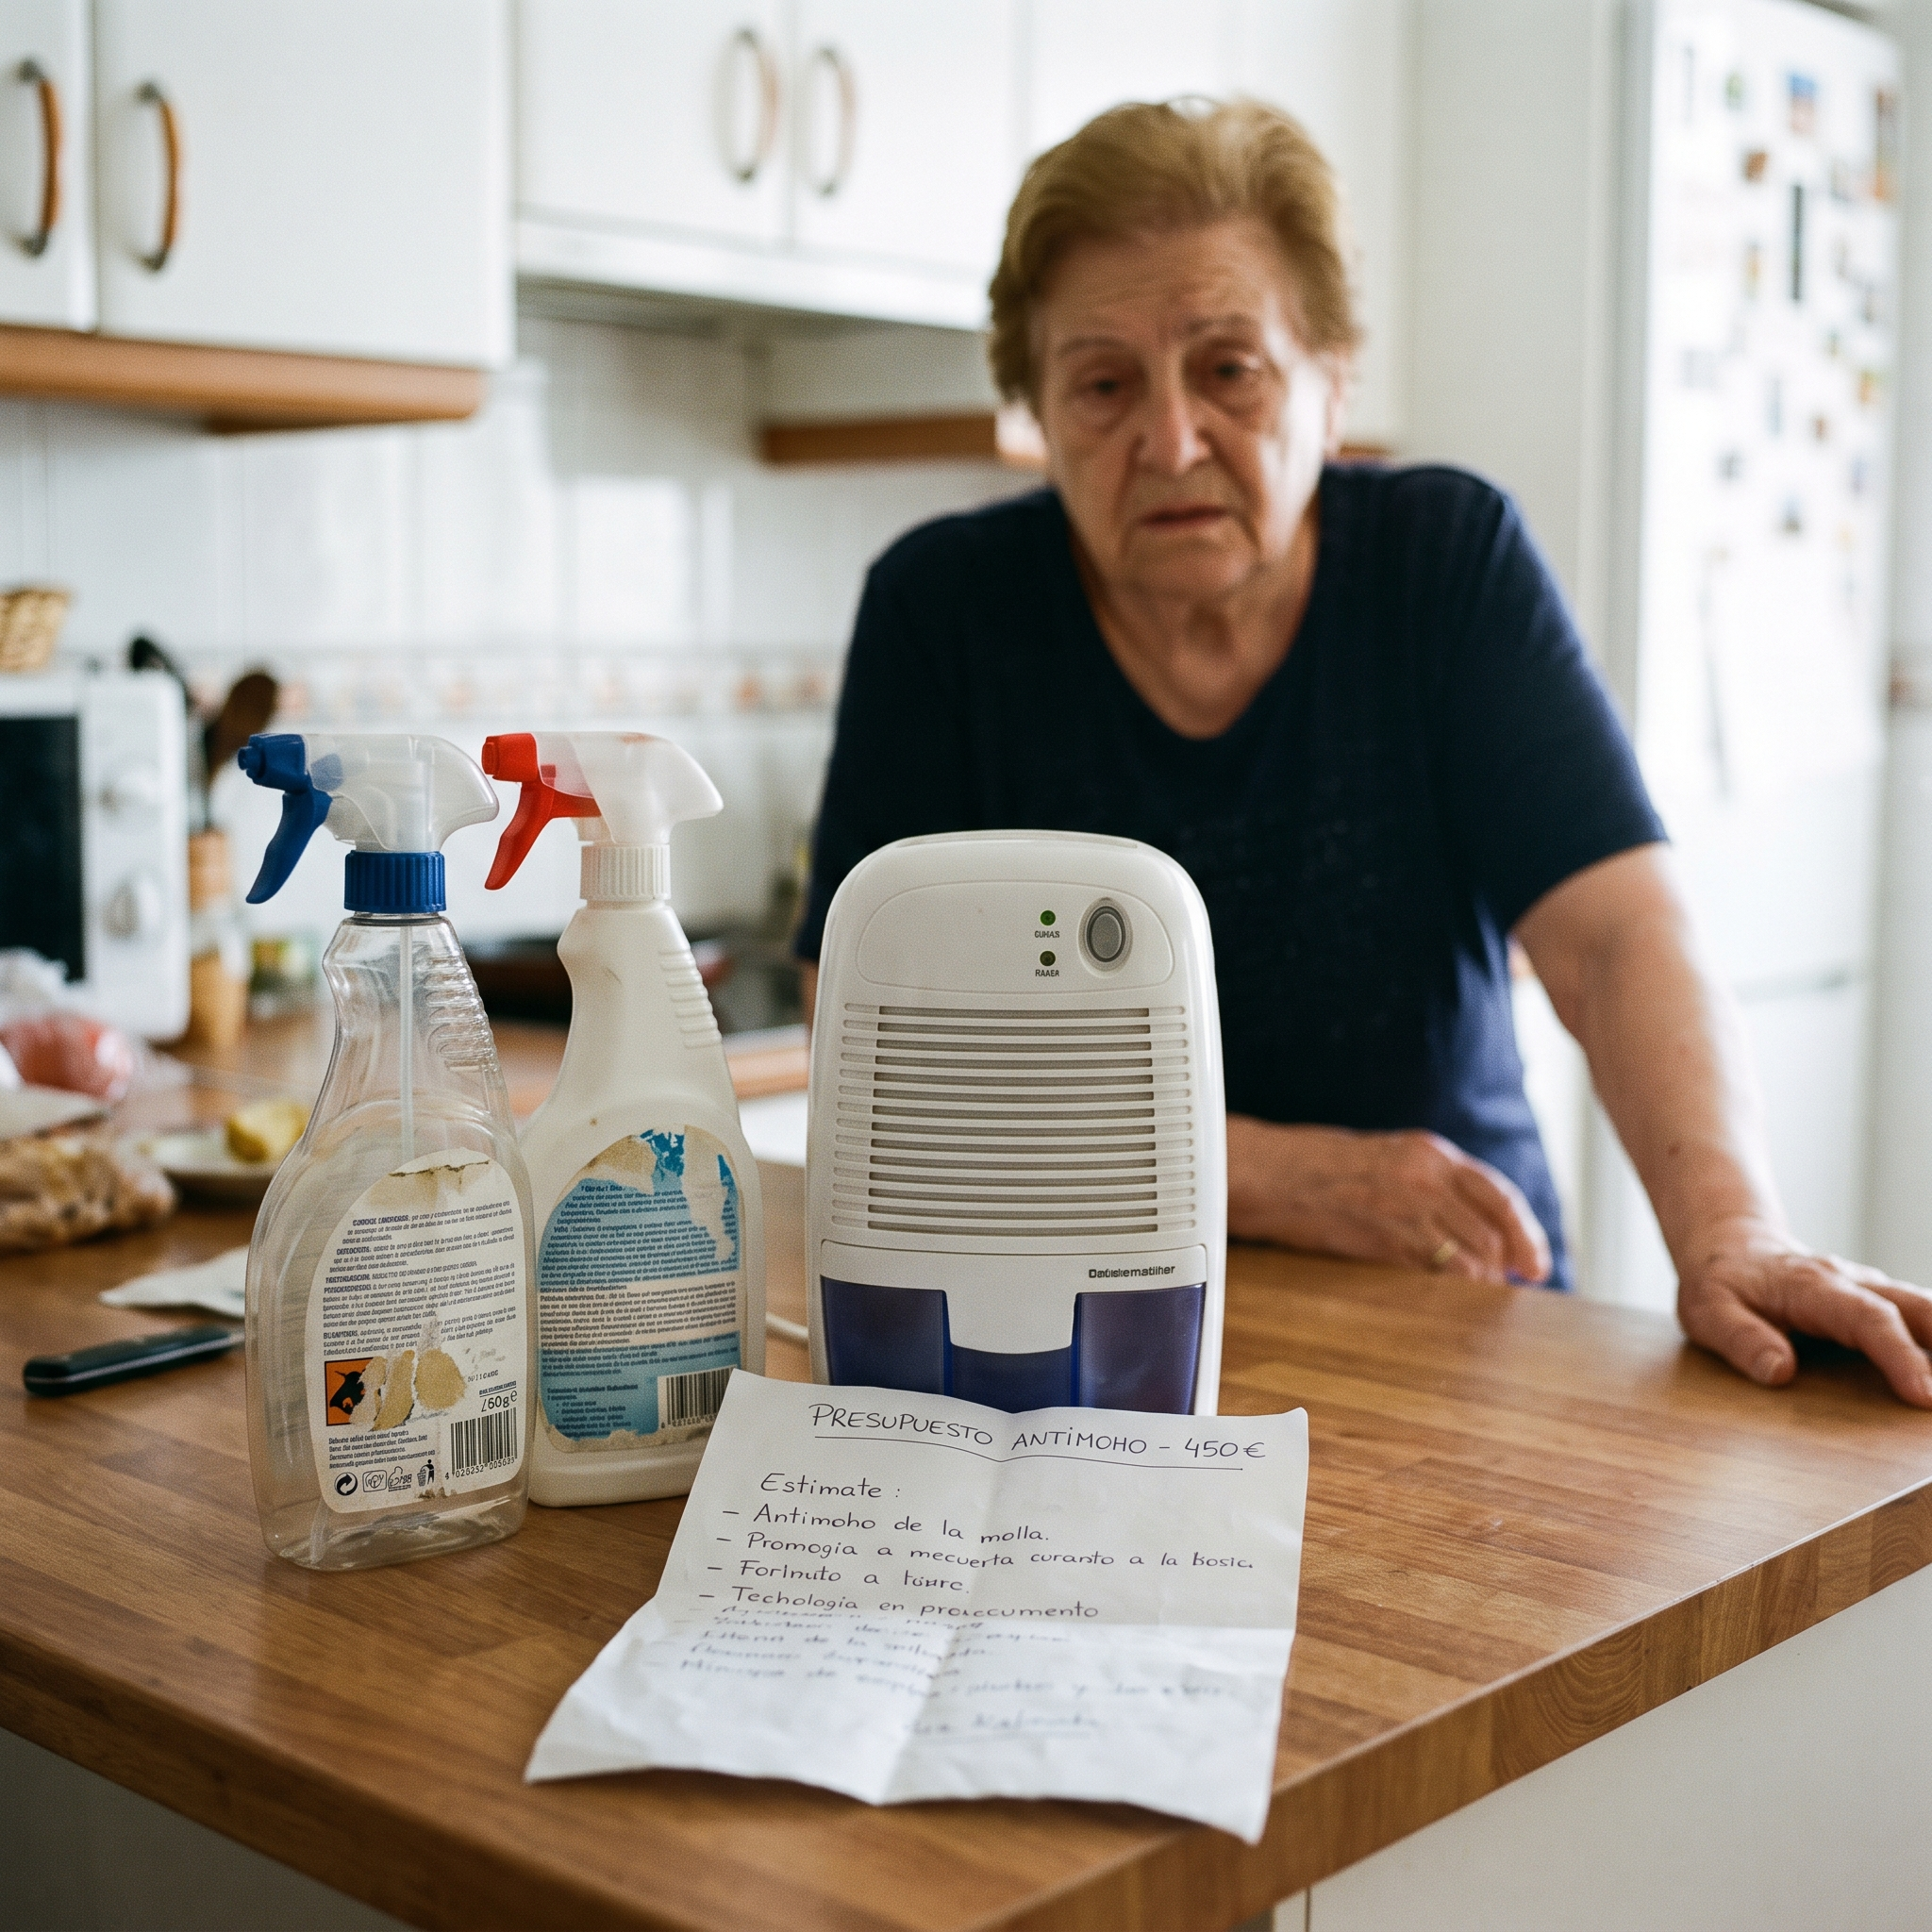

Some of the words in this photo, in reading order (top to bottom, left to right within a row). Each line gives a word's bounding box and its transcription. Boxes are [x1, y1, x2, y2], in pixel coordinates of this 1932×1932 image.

[808, 1403, 993, 1445] PRESUPUESTO
[1184, 1437, 1266, 1458] 450€
[759, 1472, 882, 1499] Estimate
[752, 1503, 876, 1530] Antimoho
[893, 1515, 923, 1532] de
[942, 1519, 964, 1540] la
[876, 1546, 893, 1557] a
[1128, 1556, 1144, 1565] a
[1160, 1552, 1178, 1567] la
[863, 1574, 880, 1585] a
[878, 1601, 905, 1611] en
